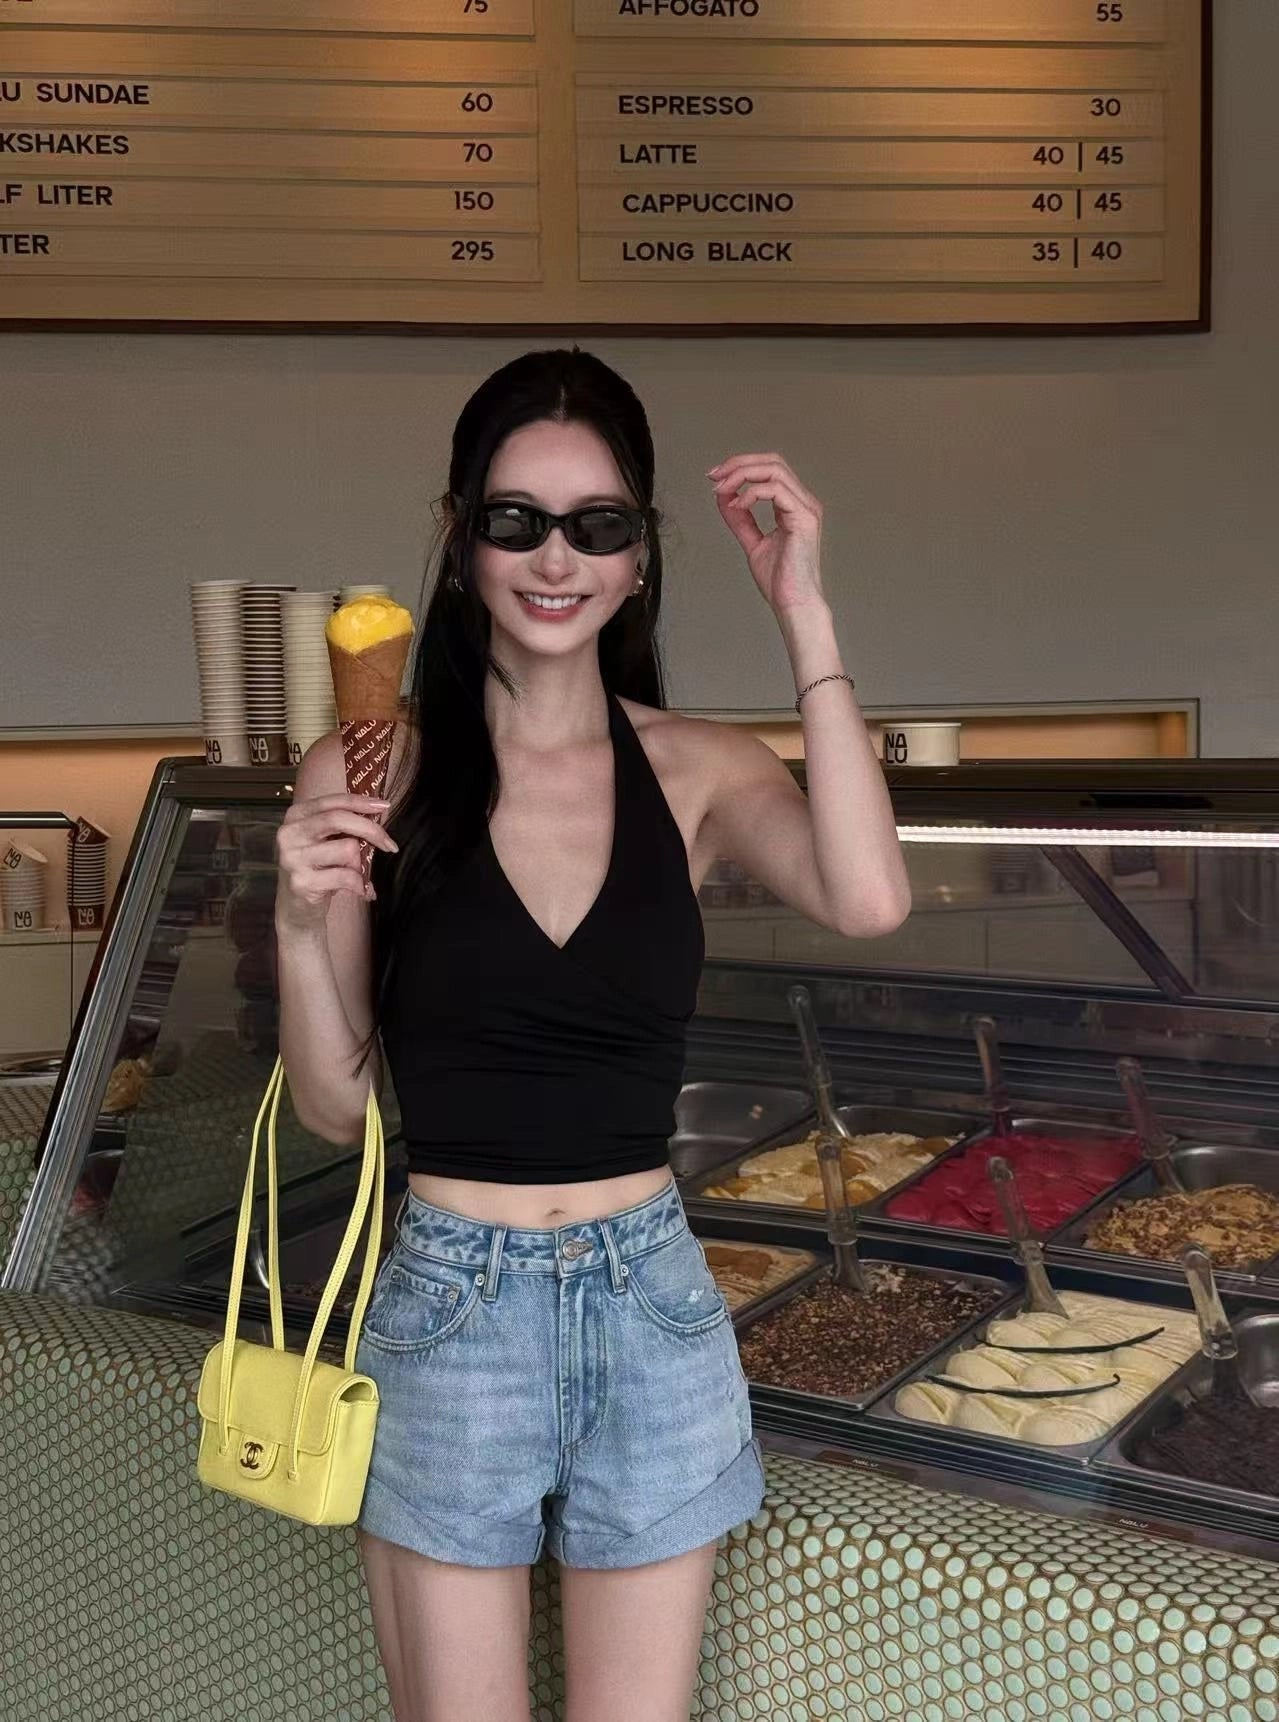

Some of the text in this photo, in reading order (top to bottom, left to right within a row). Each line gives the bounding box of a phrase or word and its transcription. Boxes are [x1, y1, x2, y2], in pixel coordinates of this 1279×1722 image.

[463, 0, 489, 14] 75
[618, 0, 760, 17] AFFOGATO
[1096, 3, 1123, 23] 55
[0, 82, 150, 105] U SUNDAE
[461, 92, 494, 113] 60
[618, 95, 754, 116] ESPRESSO
[1090, 98, 1121, 117] 30
[463, 142, 493, 163] 70
[620, 143, 698, 164] LATTE
[1033, 146, 1064, 165] 40
[1095, 146, 1124, 165] 45
[37, 184, 113, 206] LITER
[455, 190, 494, 211] 150
[622, 192, 794, 213] CAPPUCCINO
[1032, 193, 1063, 213] 40
[1094, 193, 1122, 212] 45
[451, 240, 494, 261] 295
[622, 241, 793, 262] LONG BLACK
[1032, 242, 1060, 262] 35
[1091, 241, 1122, 261] 40
[249, 737, 269, 751] NA
[886, 733, 907, 748] NA
[353, 741, 375, 762] NALU
[886, 749, 907, 764] LU
[351, 762, 373, 789] NALU
